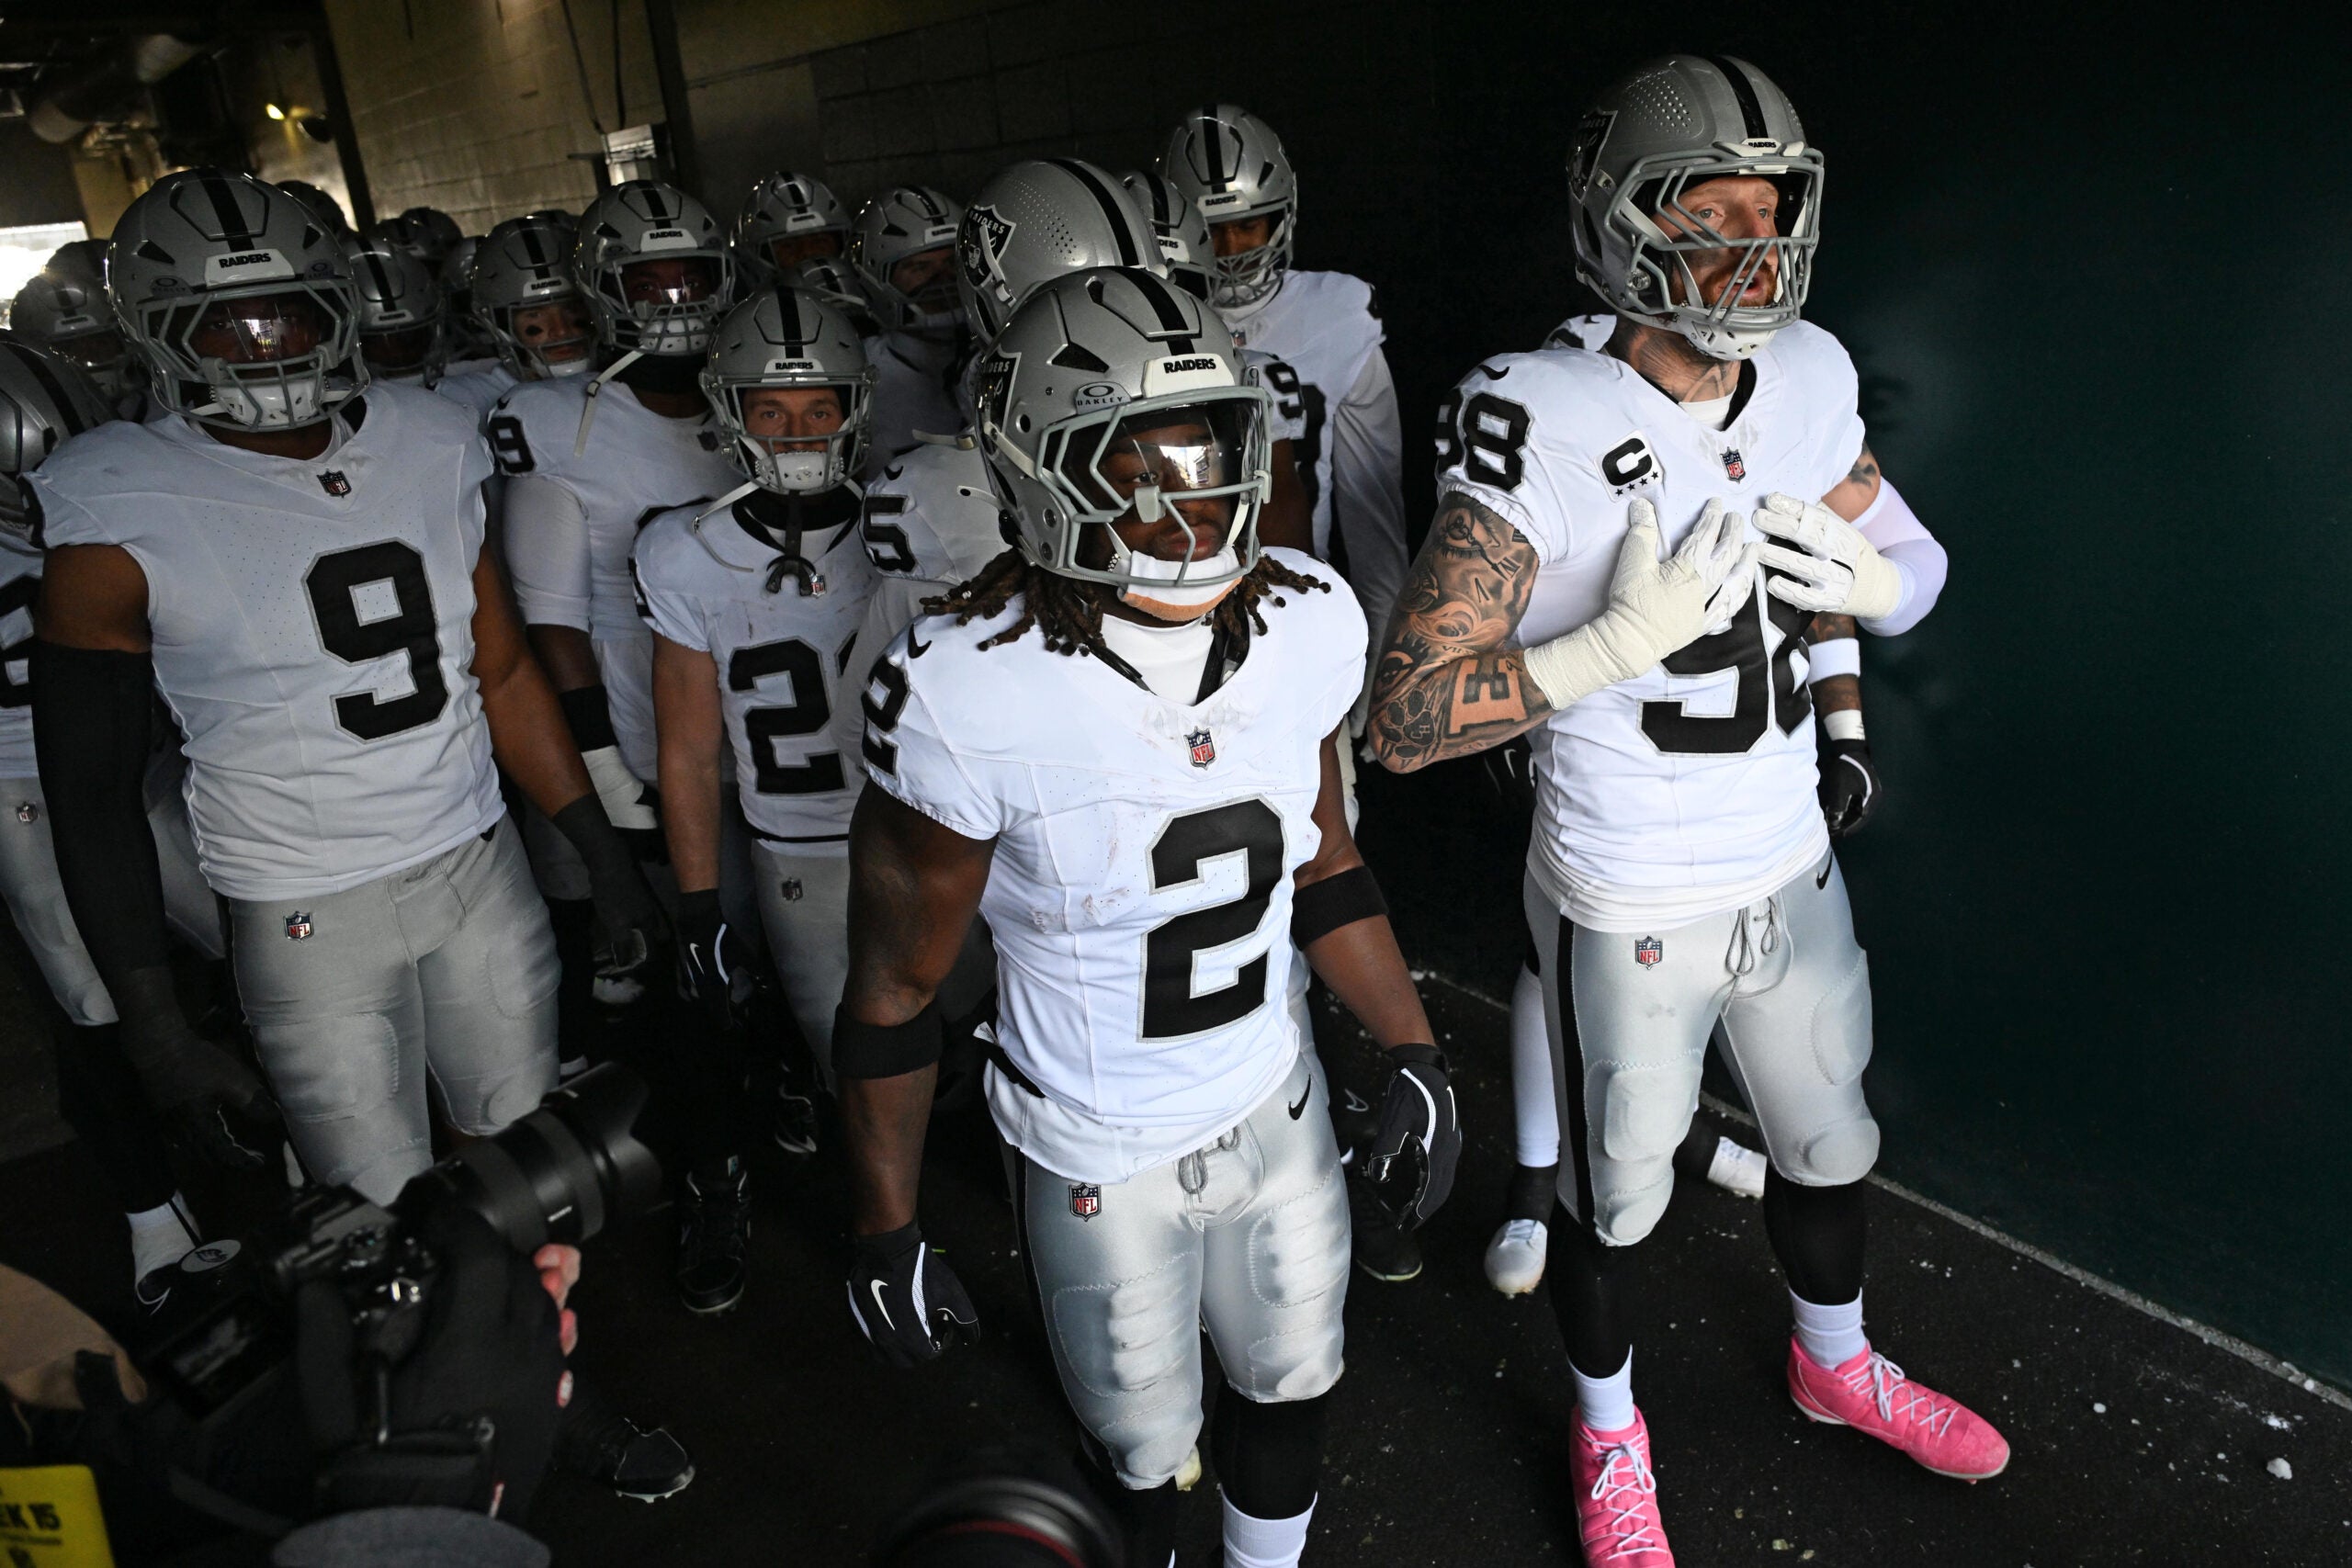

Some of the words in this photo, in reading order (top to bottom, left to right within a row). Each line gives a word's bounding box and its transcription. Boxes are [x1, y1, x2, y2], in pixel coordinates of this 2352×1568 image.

[650, 231, 683, 240] RAIDERS
[1159, 239, 1179, 249] DERS
[219, 253, 271, 268] RAIDERS
[775, 362, 813, 370] RAIDERS
[1163, 358, 1216, 374] RAIDERS
[1077, 396, 1124, 406] OAKLEY
[1601, 437, 1653, 487] C
[301, 536, 450, 743] 9
[1193, 744, 1214, 762] NFL
[1138, 795, 1285, 1042] 2
[288, 924, 311, 938] NFL
[1640, 950, 1659, 964] NFL
[1074, 1197, 1097, 1213] NFL
